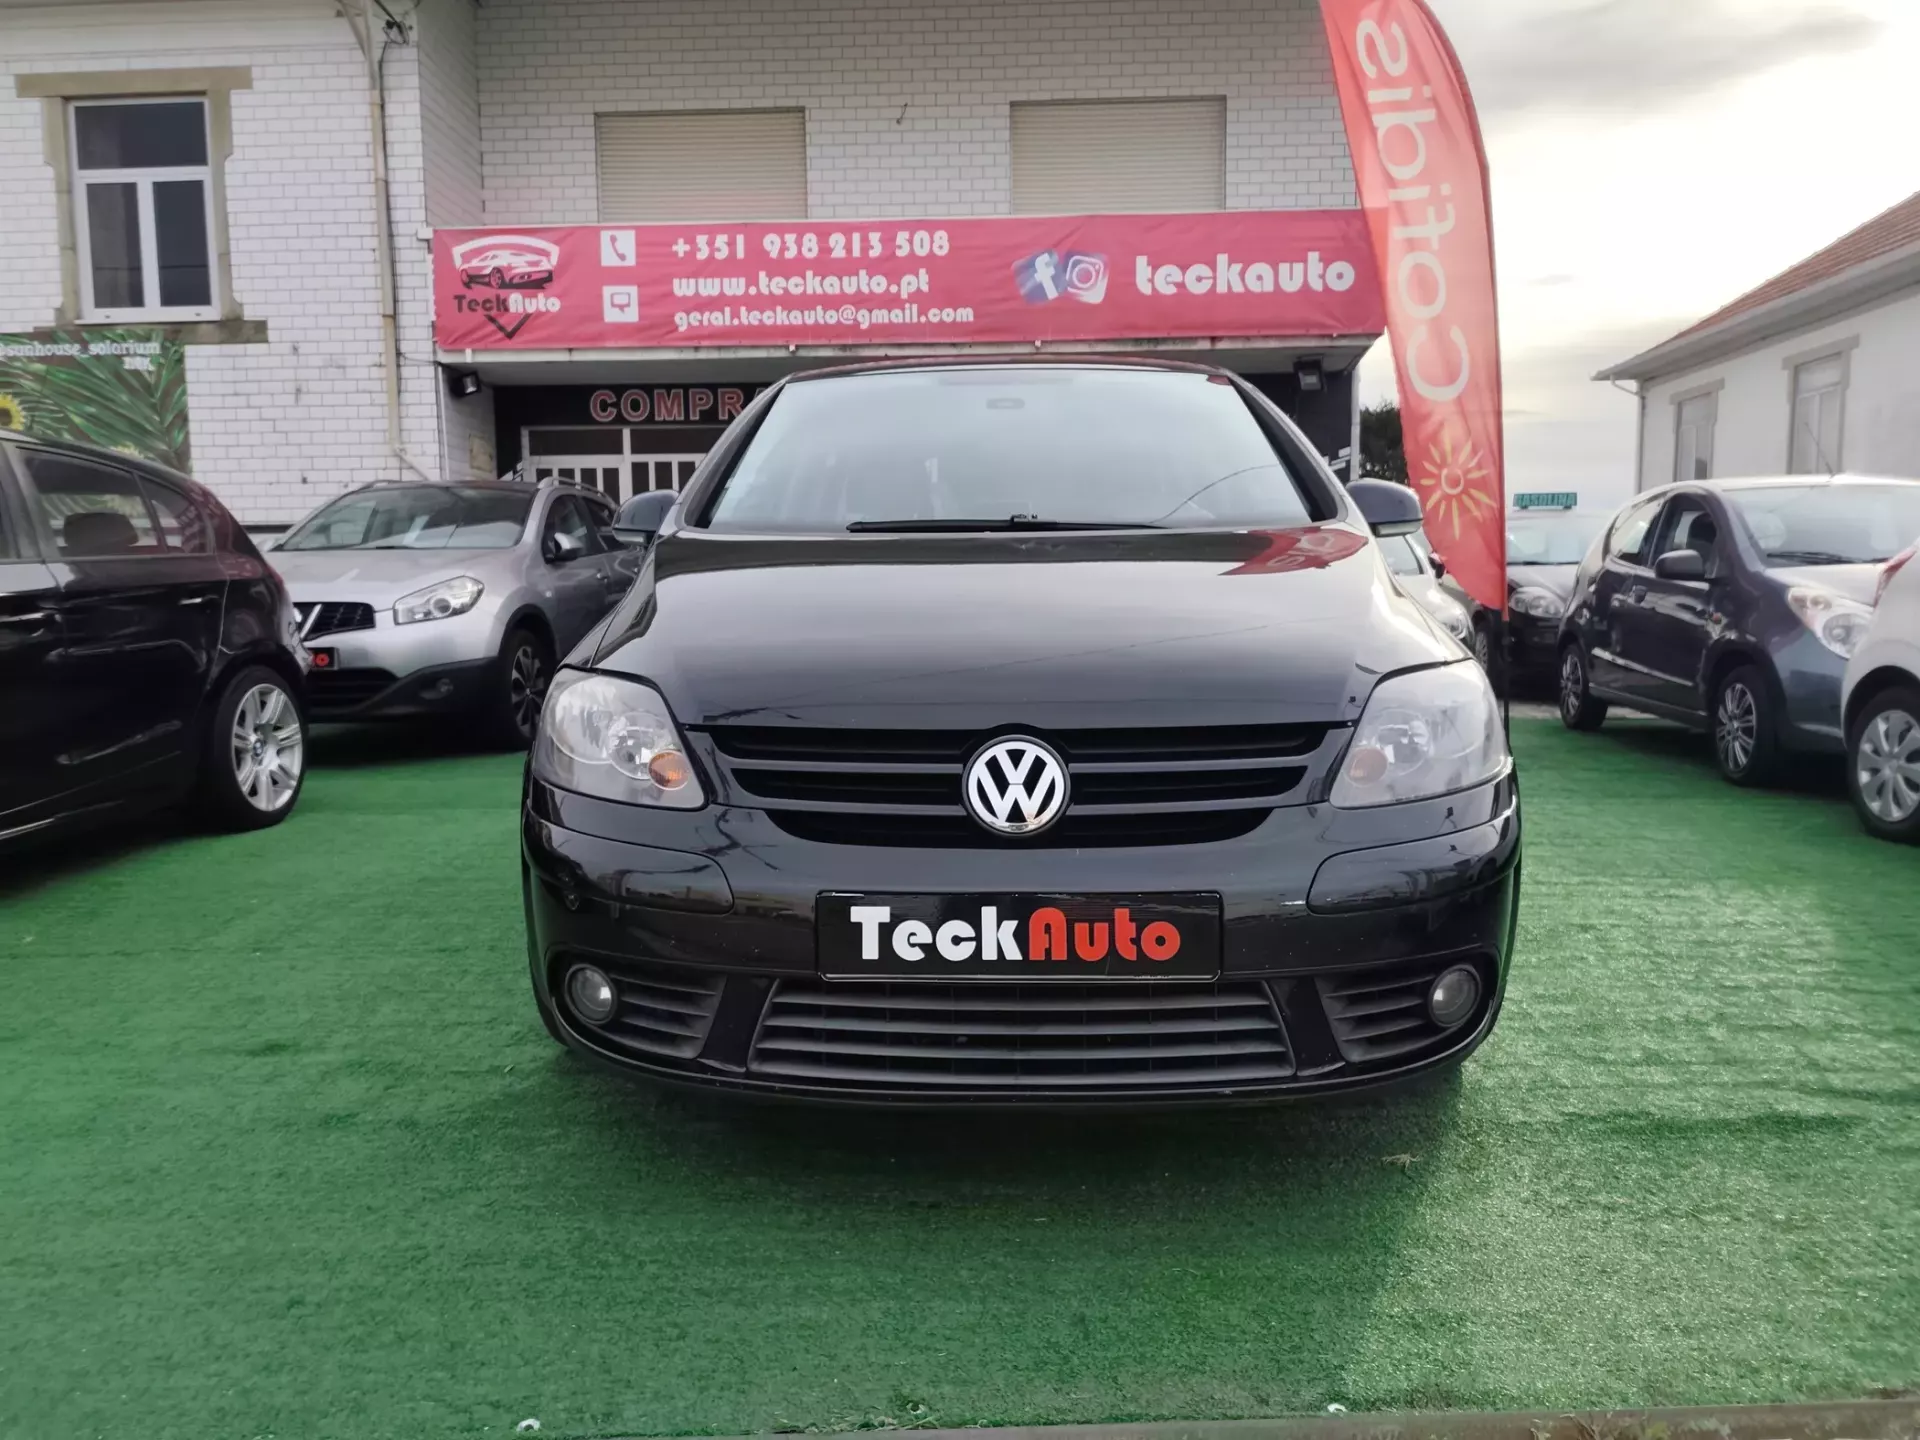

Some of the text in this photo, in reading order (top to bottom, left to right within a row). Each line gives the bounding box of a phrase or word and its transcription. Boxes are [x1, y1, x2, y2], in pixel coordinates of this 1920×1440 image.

[671, 229, 951, 260] +351 938 213 508
[671, 267, 931, 299] www.teckauto.pt
[1134, 251, 1357, 296] teckauto
[453, 291, 562, 314] TeckAuto
[673, 302, 975, 333] geral.teckauto@gmail.com
[589, 387, 768, 422] COMPR
[849, 905, 1182, 962] TeckAuto
